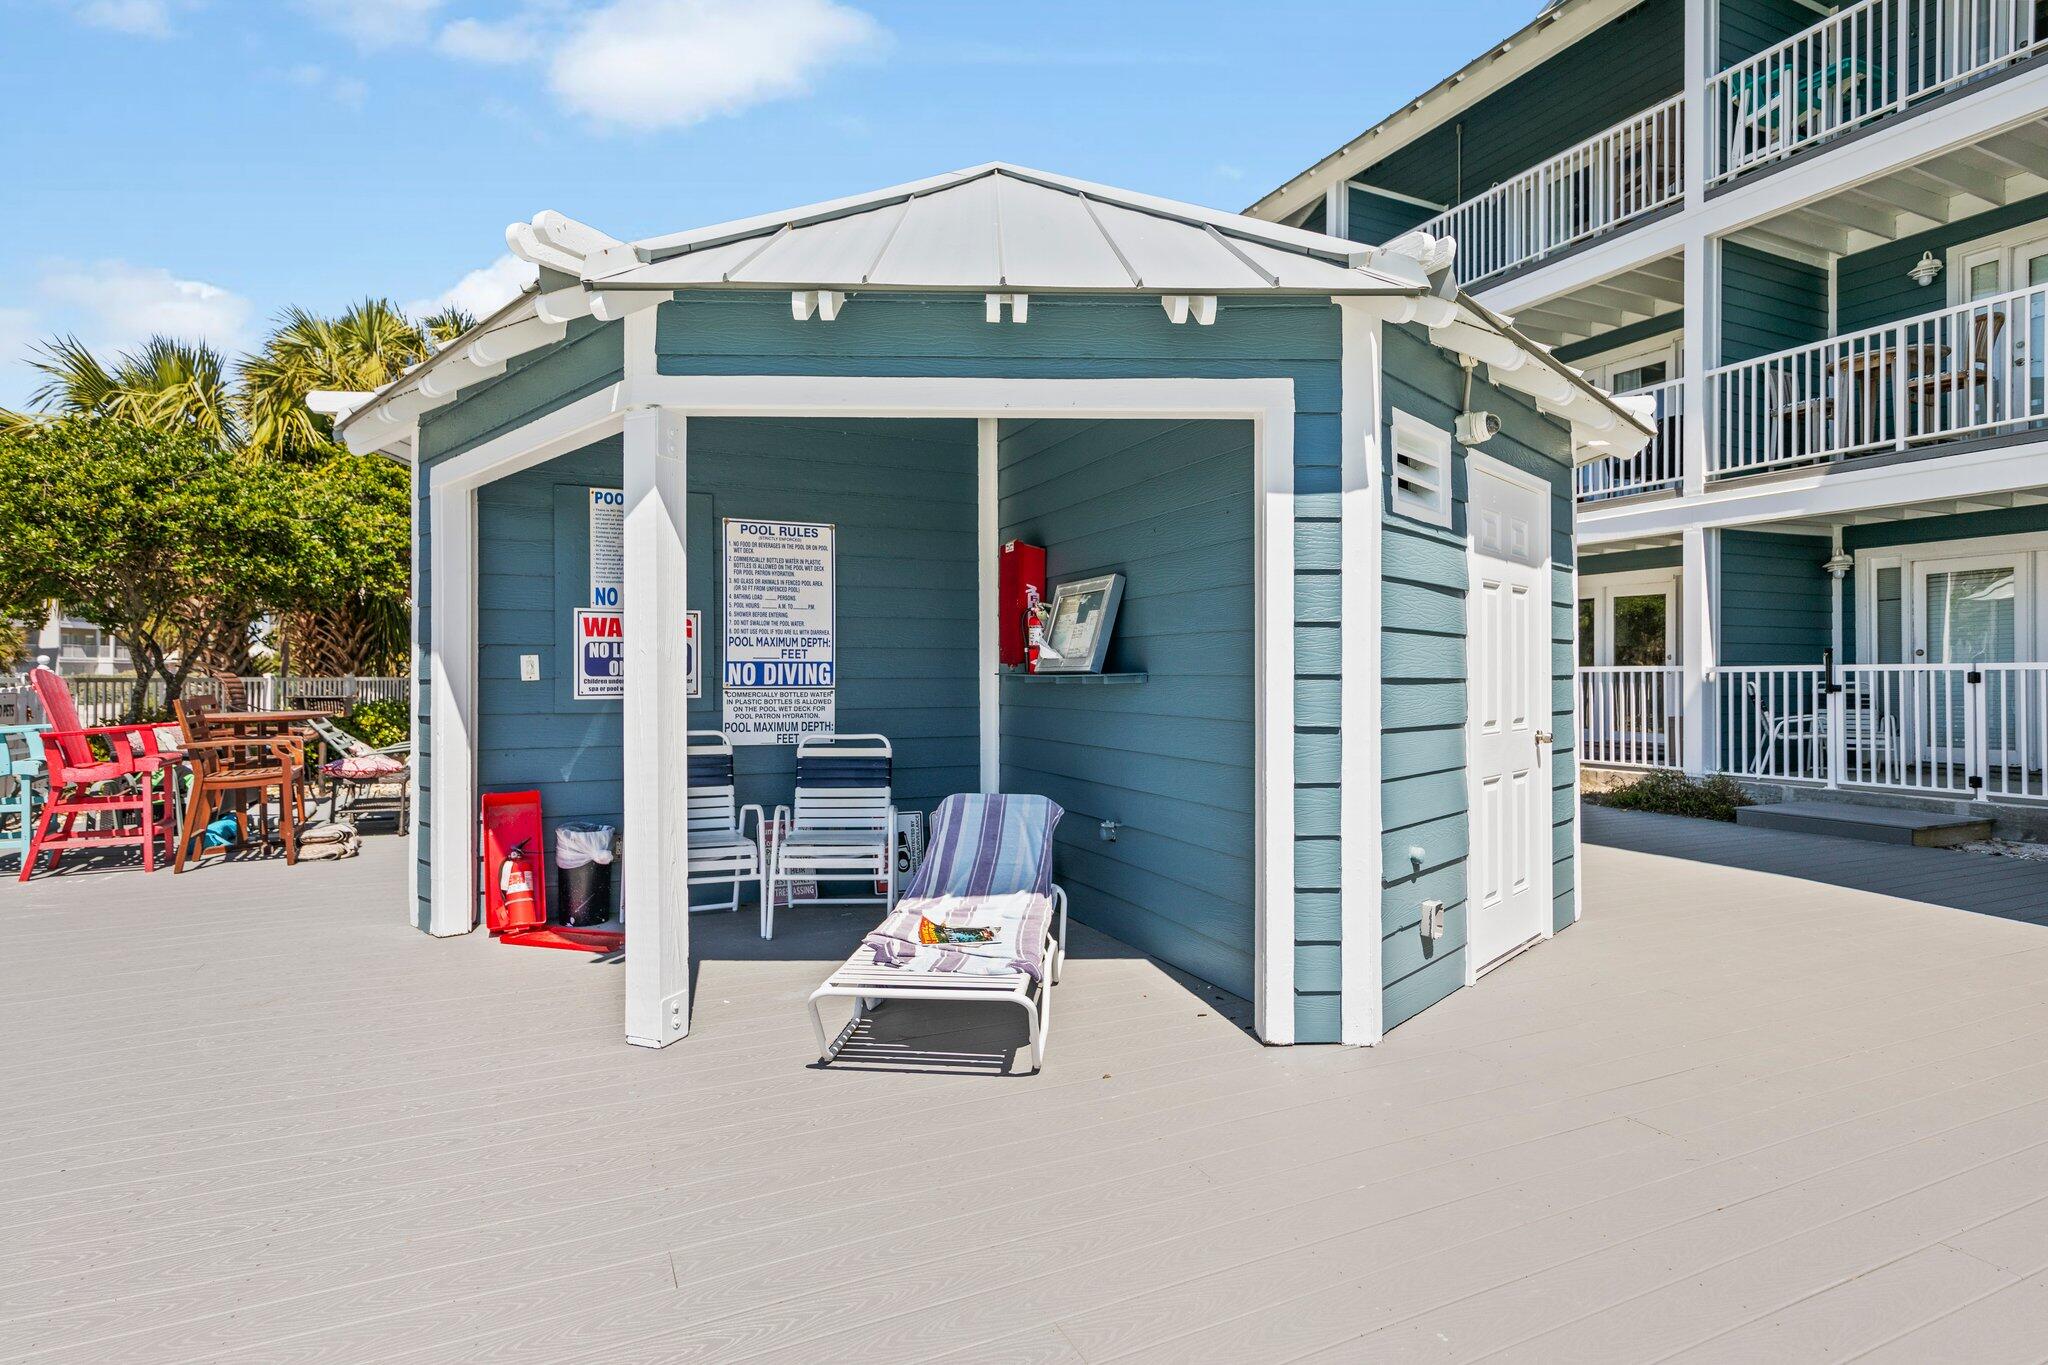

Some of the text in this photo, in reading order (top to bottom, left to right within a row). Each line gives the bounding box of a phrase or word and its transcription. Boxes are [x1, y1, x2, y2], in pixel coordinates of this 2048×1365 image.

[595, 492, 624, 505] POO
[741, 525, 819, 538] POOL RULES
[595, 588, 618, 606] NO
[729, 637, 831, 648] POOL MAXIMUM DEPTH:
[590, 643, 609, 658] NO
[781, 649, 808, 659] FEET
[728, 663, 831, 685] NO DIVING
[725, 722, 834, 733] POOL MAXIMUM DEPTH:
[777, 734, 800, 744] FEET
